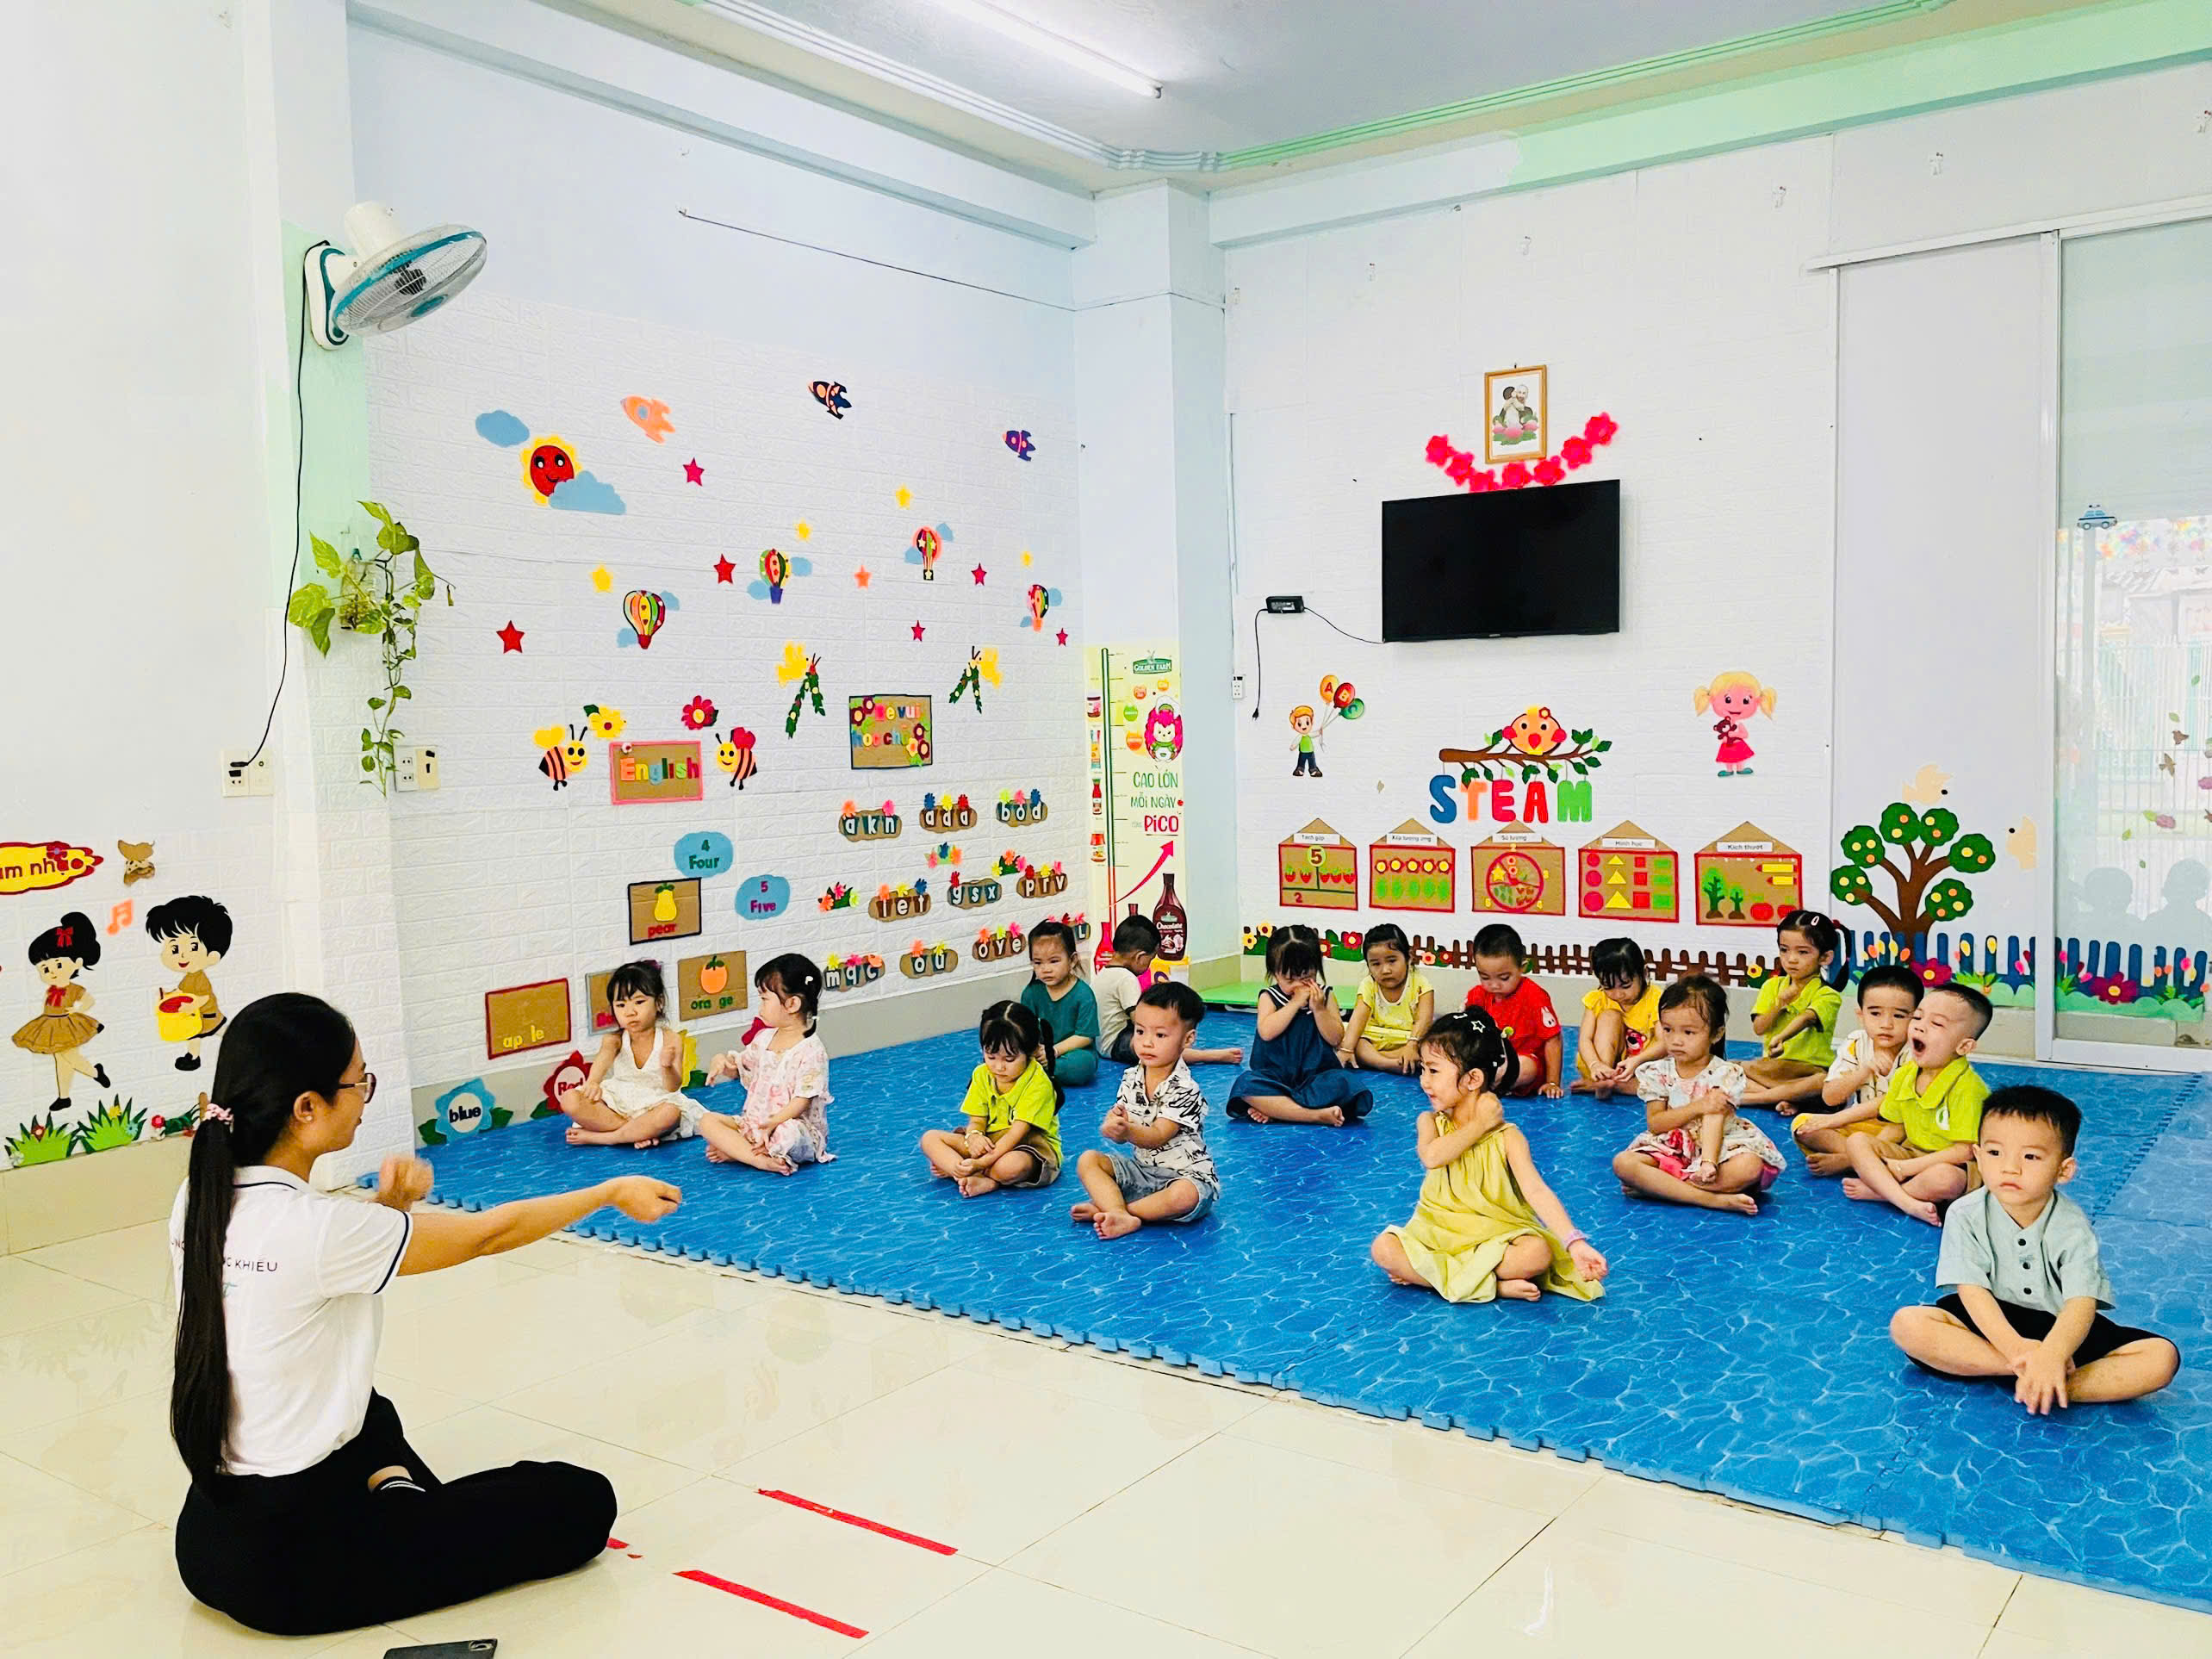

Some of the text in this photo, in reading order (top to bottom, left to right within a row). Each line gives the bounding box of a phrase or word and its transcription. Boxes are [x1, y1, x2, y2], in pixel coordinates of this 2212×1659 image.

[1324, 681, 1333, 693] A
[619, 757, 700, 786] English
[1133, 771, 1155, 788] CAO
[1429, 774, 1593, 824] STEAM
[701, 839, 711, 852] 4
[688, 854, 720, 870] Four
[1310, 848, 1323, 865] 5
[0, 865, 22, 879] m
[761, 880, 768, 893] 5
[1294, 892, 1303, 904] 2
[750, 900, 777, 914] Five
[648, 923, 677, 938] pear
[449, 1106, 482, 1123] blue
